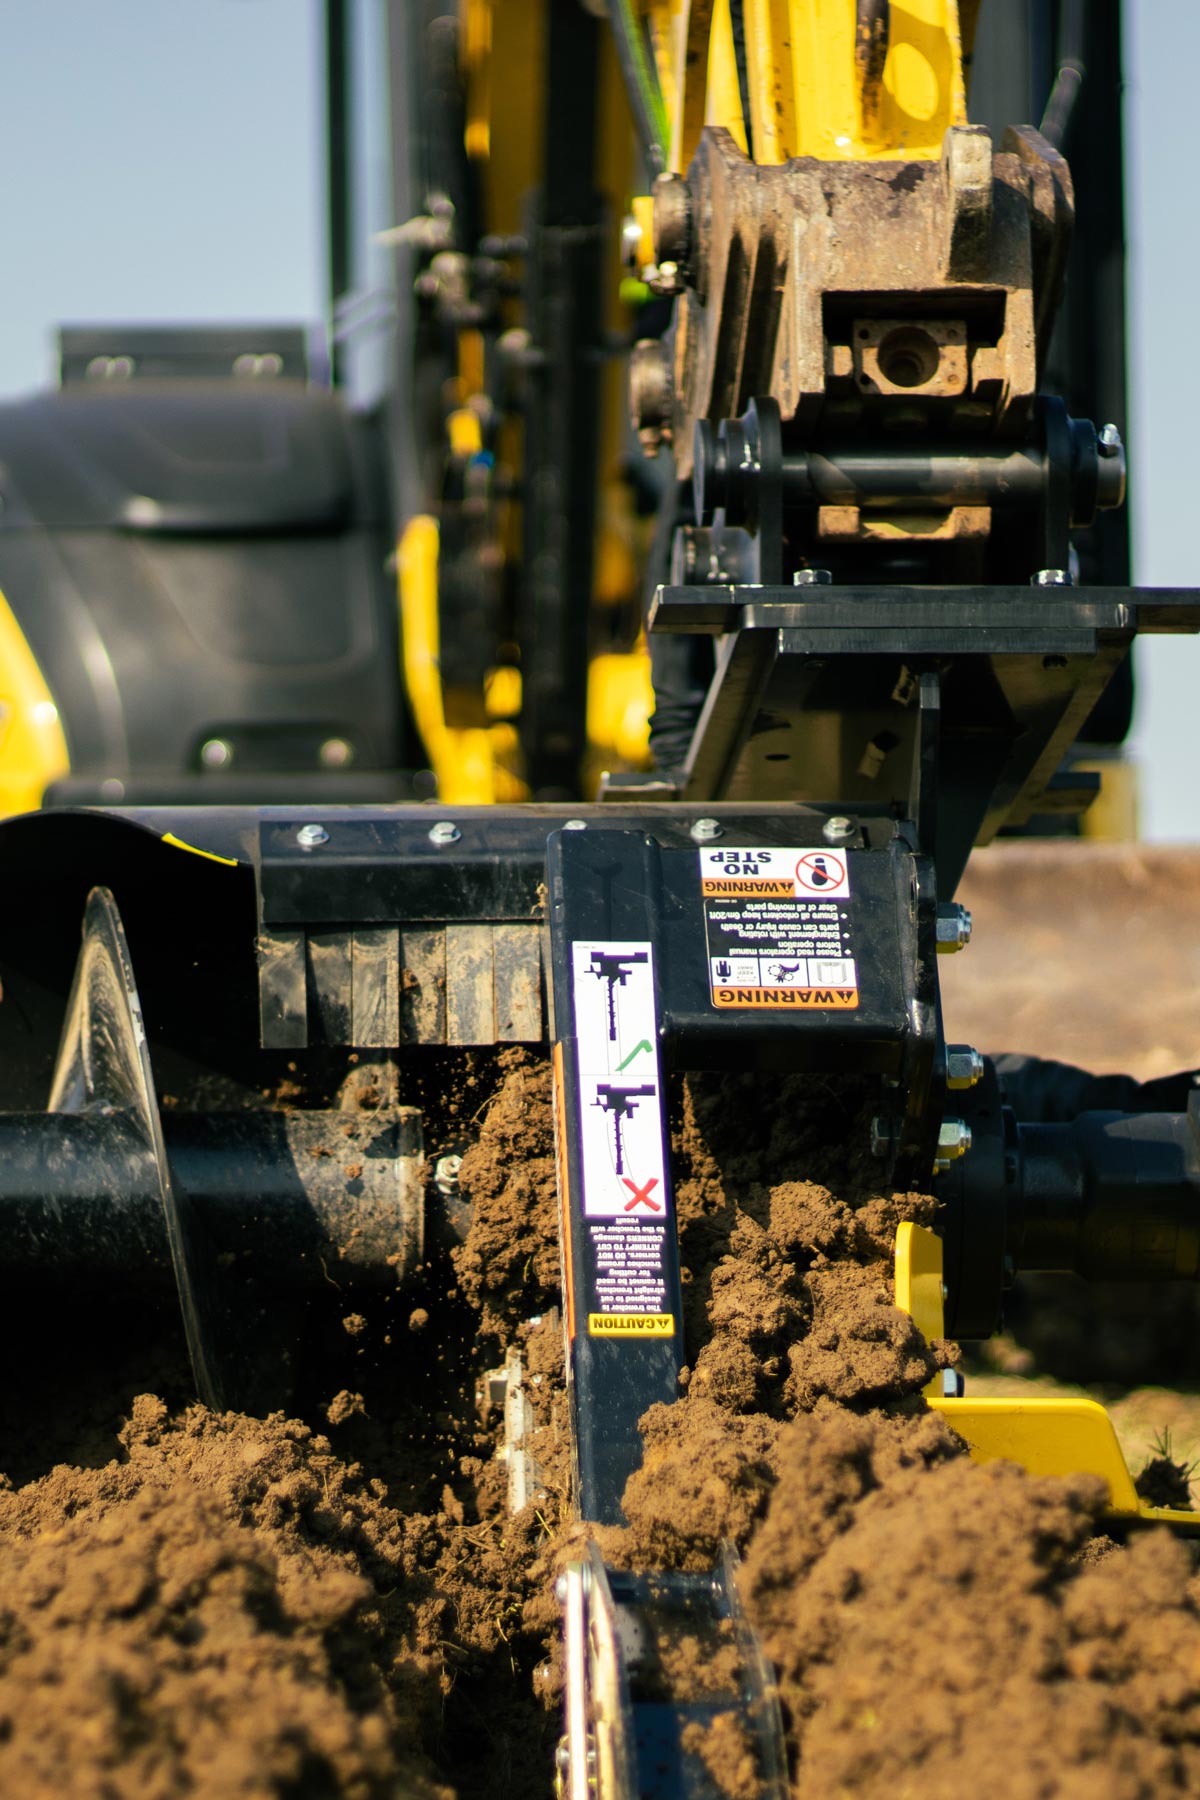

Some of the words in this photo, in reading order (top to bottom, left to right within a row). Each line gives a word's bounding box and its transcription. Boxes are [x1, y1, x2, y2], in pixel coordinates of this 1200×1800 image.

[710, 852, 772, 863] STEP
[724, 864, 759, 875] NO
[705, 882, 779, 892] WARNING
[746, 903, 766, 911] parts
[768, 903, 795, 911] moving
[742, 911, 761, 920] keep
[812, 912, 838, 920] Ensure
[720, 923, 743, 931] death
[756, 922, 777, 931] injury
[819, 923, 840, 931] parts
[739, 930, 768, 938] rotating
[788, 930, 840, 939] Entanglement
[778, 940, 814, 948] operation
[758, 948, 795, 956] operators
[719, 990, 835, 1003] WARNING
[593, 1318, 655, 1329] CAUTION
